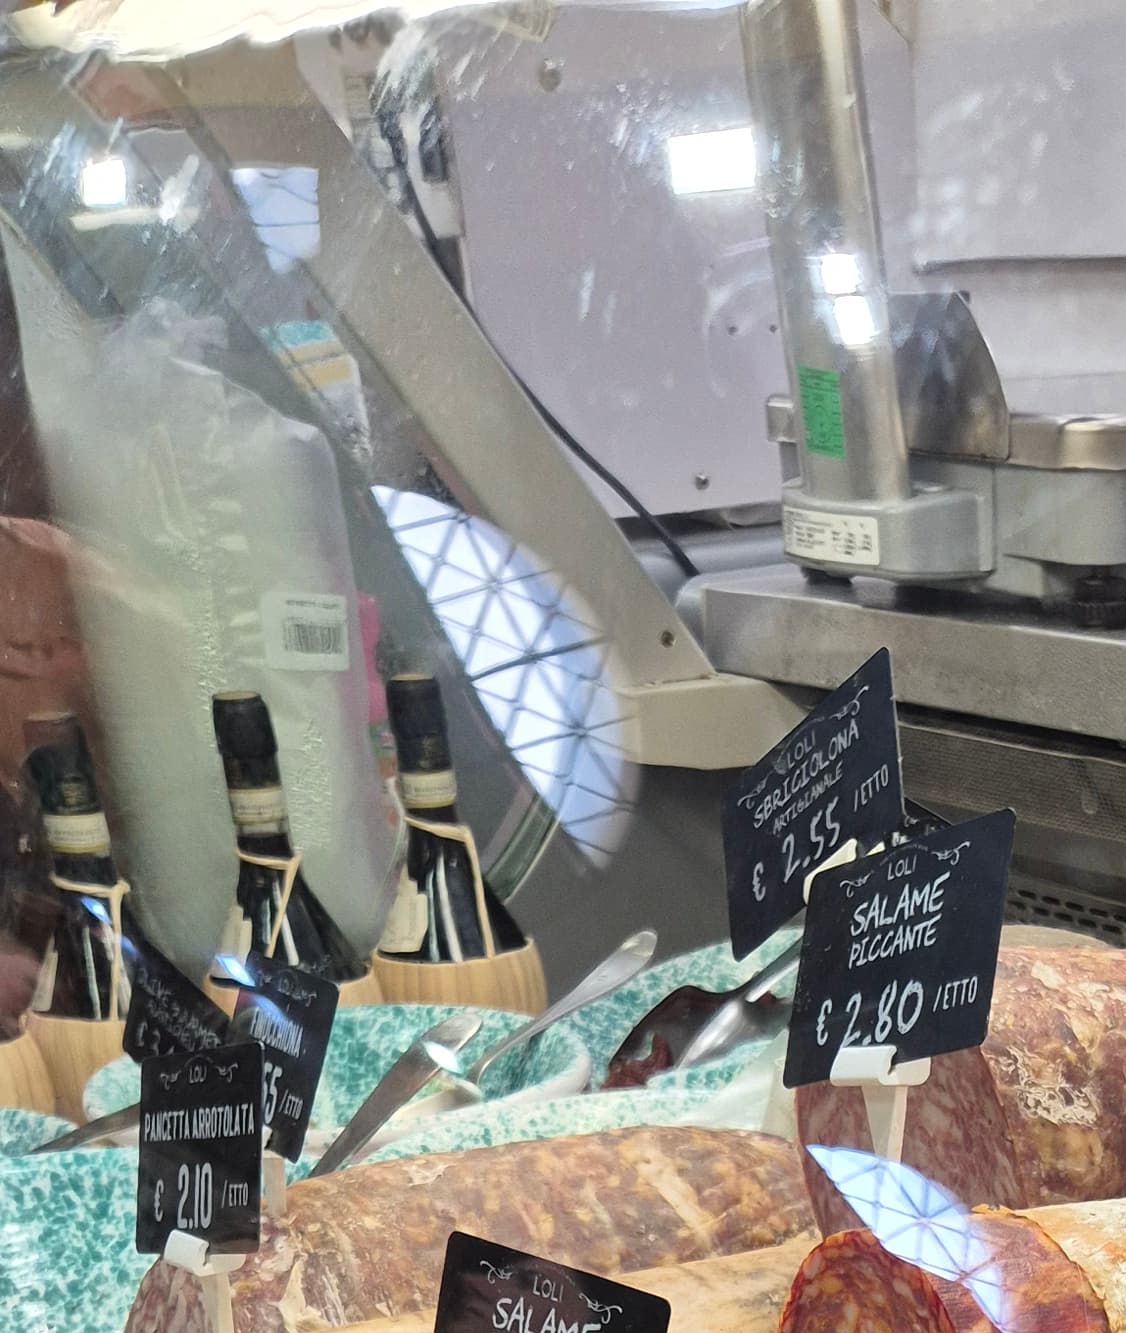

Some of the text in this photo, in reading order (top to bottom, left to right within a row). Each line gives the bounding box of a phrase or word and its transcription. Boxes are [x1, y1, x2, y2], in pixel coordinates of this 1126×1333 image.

[753, 718, 859, 828] SBRICIOLONA
[786, 731, 816, 769] LOLI
[772, 761, 843, 835] ARTIGIANALE
[752, 861, 766, 901] €
[782, 796, 841, 884] 2.55
[887, 856, 917, 880] LOLI
[850, 872, 951, 937] SALAME
[849, 913, 942, 969] PICCANTE
[816, 999, 832, 1046] €
[842, 980, 923, 1048] 2.80
[144, 1102, 255, 1142] PANCETTA ARROTOLATA
[154, 1179, 164, 1222] €
[177, 1162, 213, 1230] 2.10
[532, 1275, 564, 1302] LOLI
